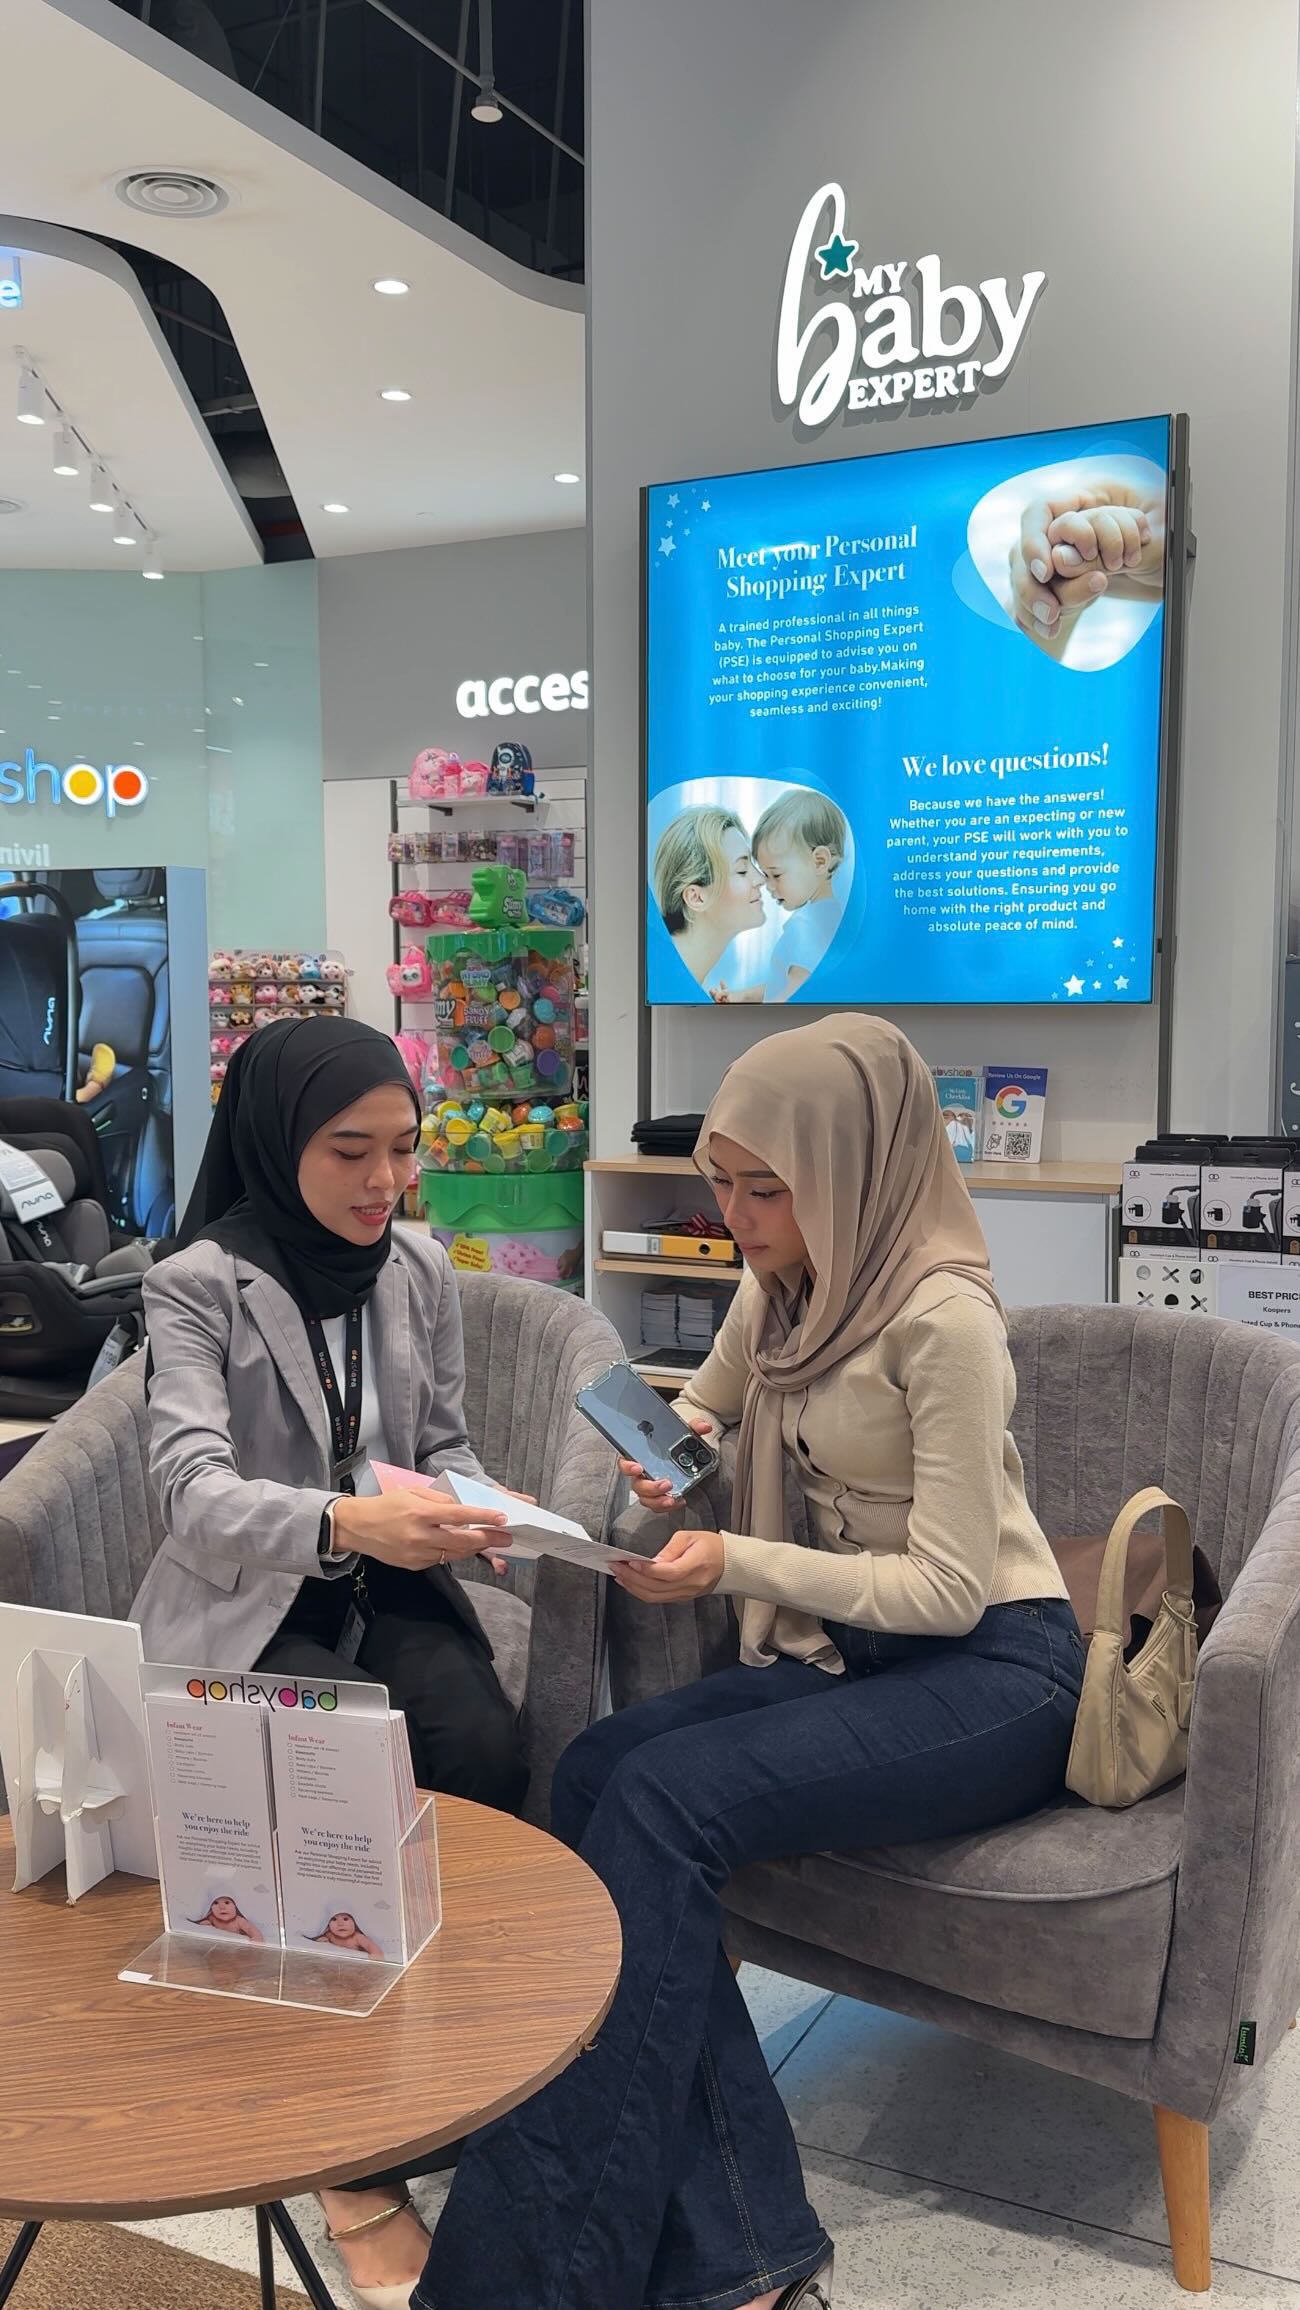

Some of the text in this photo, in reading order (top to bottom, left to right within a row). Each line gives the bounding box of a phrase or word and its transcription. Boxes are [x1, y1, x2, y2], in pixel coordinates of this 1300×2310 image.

[854, 261, 908, 298] MY
[847, 360, 984, 410] EXPERT
[717, 523, 918, 571] Meet your Personal
[727, 561, 906, 600] Shopping Expert
[719, 606, 919, 633] A trained professional in all things
[715, 622, 923, 651] baby. The Personal Shopping Expert
[719, 642, 917, 668] (PSE) is equipped to advise you on
[713, 674, 739, 685] what
[743, 674, 752, 683] to
[757, 671, 796, 682] choose
[800, 668, 816, 678] for
[820, 666, 846, 678] your
[456, 670, 588, 718] acces
[709, 677, 928, 705] your shopping experience convenient,
[750, 697, 882, 717] seamless and exciting!
[902, 742, 1109, 779] We love questions!
[0, 748, 149, 818] shop
[910, 788, 1104, 811] Because we have the answers!
[890, 808, 1125, 829] Whether you are an expecting or new
[887, 825, 1128, 848] parent, your PSE will work with you to
[907, 845, 1105, 863] understand your requirements,
[893, 862, 1120, 882] address your questions and provide
[895, 881, 1117, 899] the best solutions. Ensuring you go
[903, 899, 1105, 915] home with the right product and
[928, 917, 1077, 933] absolute peace of mind.
[21, 1192, 54, 1209] nuna
[1248, 1291, 1274, 1299] BEST
[184, 1824, 198, 1832] you
[199, 1826, 219, 1834] enjoy
[234, 1828, 248, 1836] ride
[207, 1815, 222, 1824] here
[234, 1819, 250, 1829] help
[303, 1839, 370, 1852] you enjoy the ride
[327, 1830, 344, 1839] here
[354, 1834, 371, 1845] help
